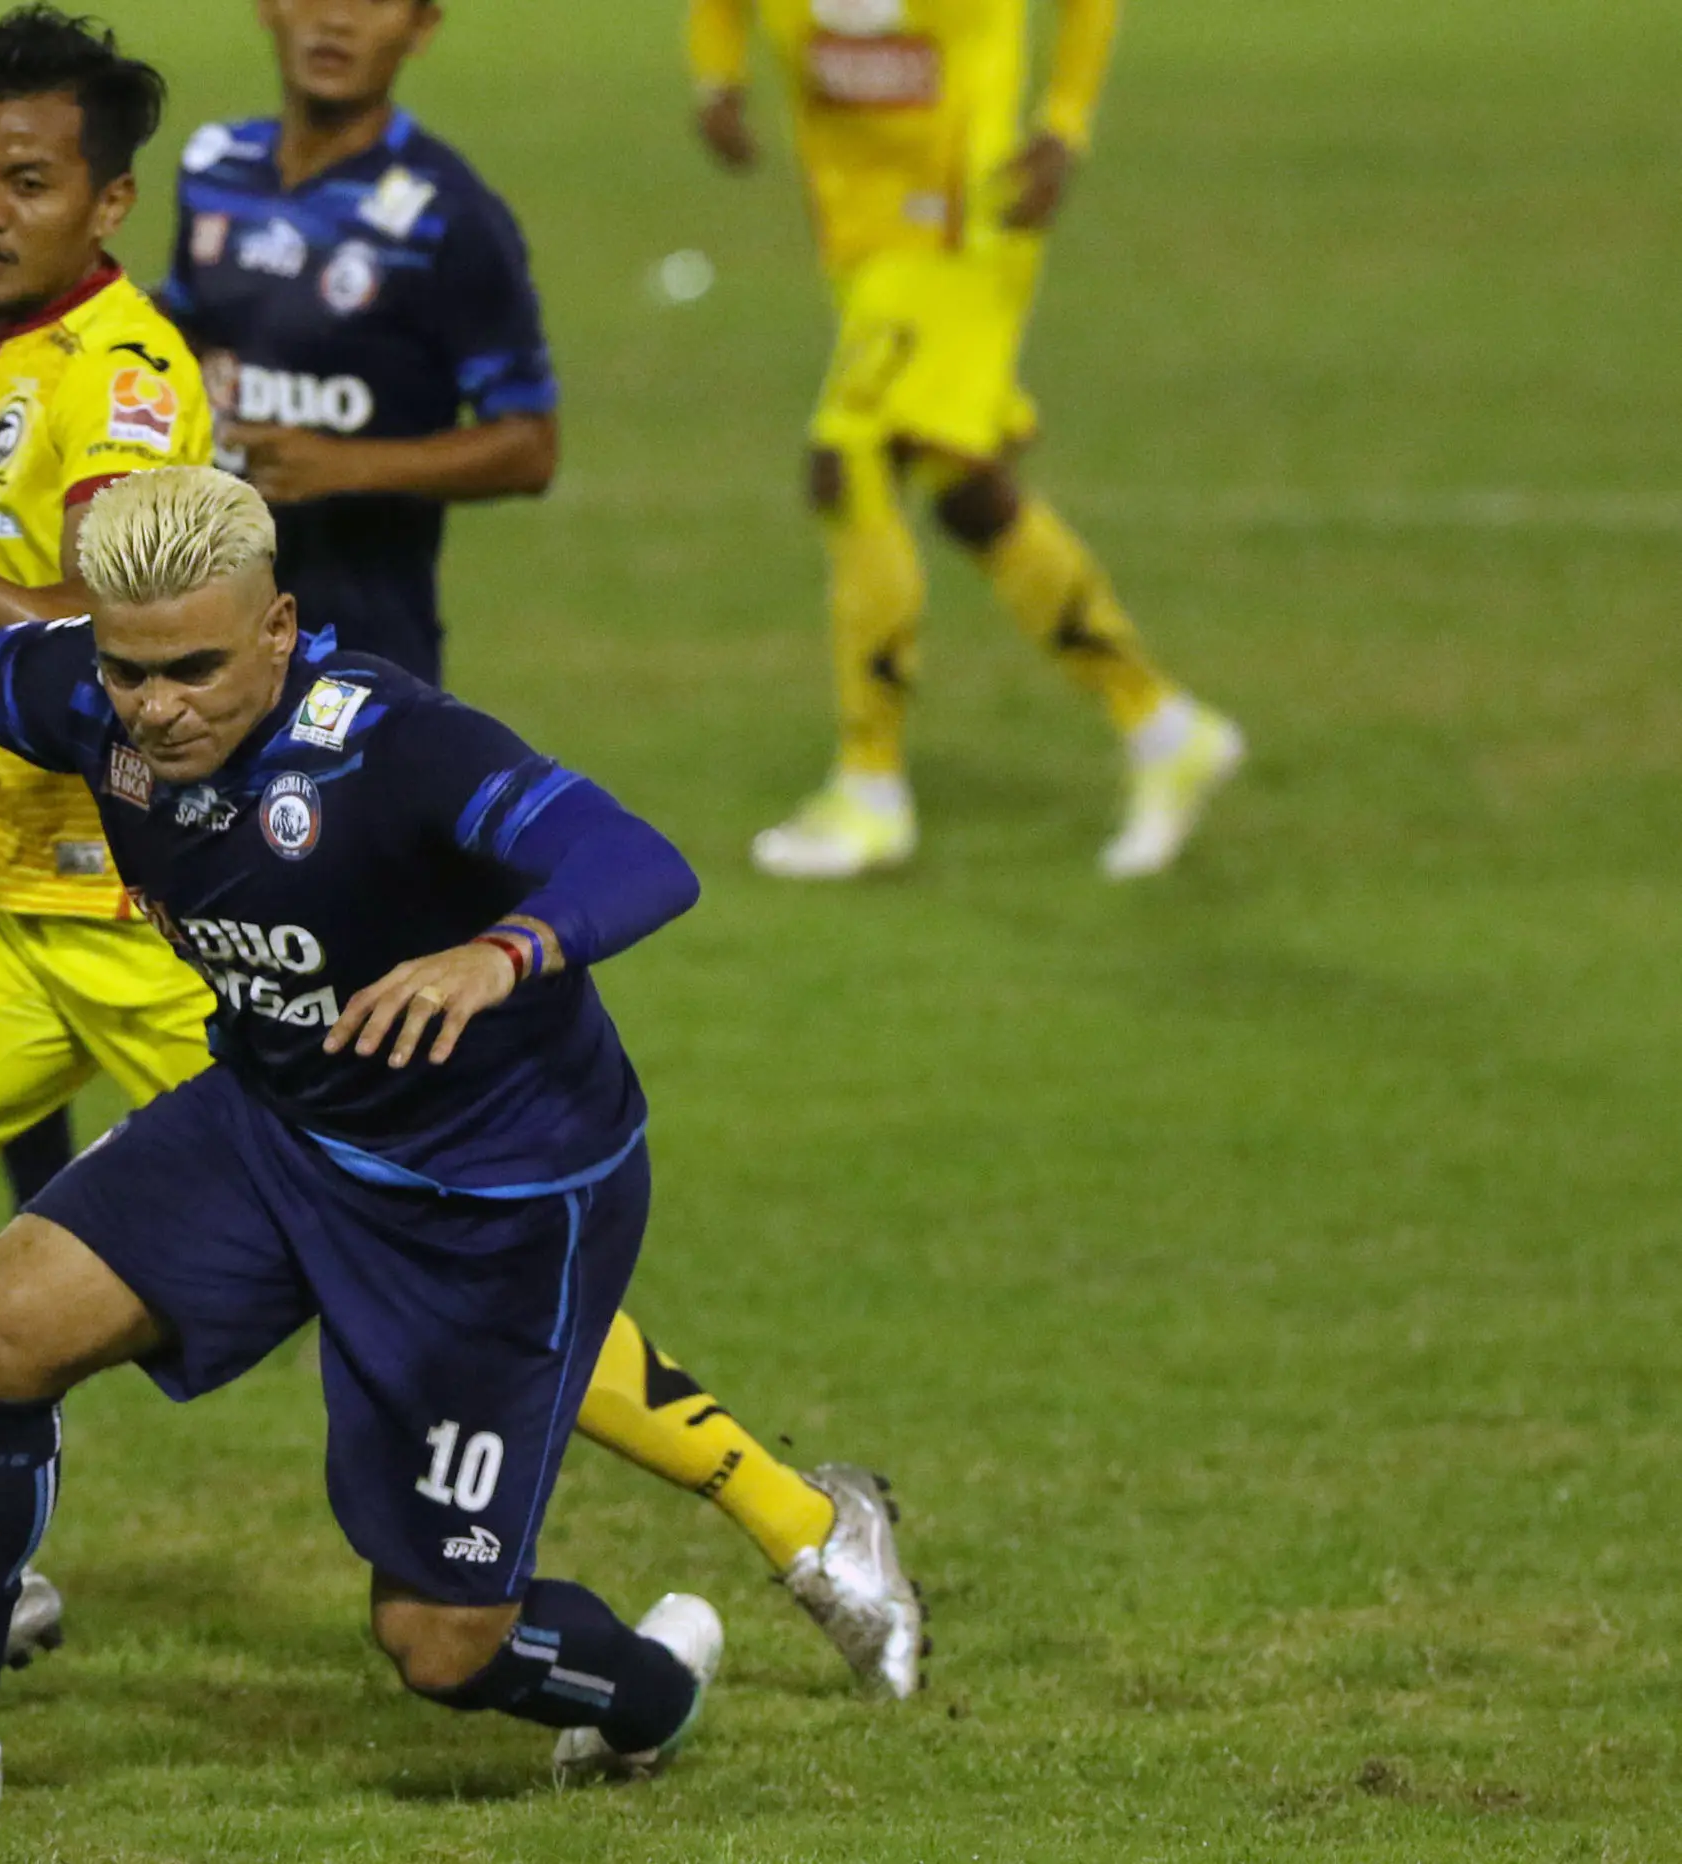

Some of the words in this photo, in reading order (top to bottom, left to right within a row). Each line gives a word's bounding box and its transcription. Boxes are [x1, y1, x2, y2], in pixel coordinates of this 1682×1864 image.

[239, 363, 373, 434] DUO
[179, 917, 324, 975] DUO
[415, 1418, 504, 1513] 10
[442, 1541, 501, 1564] SPECS
